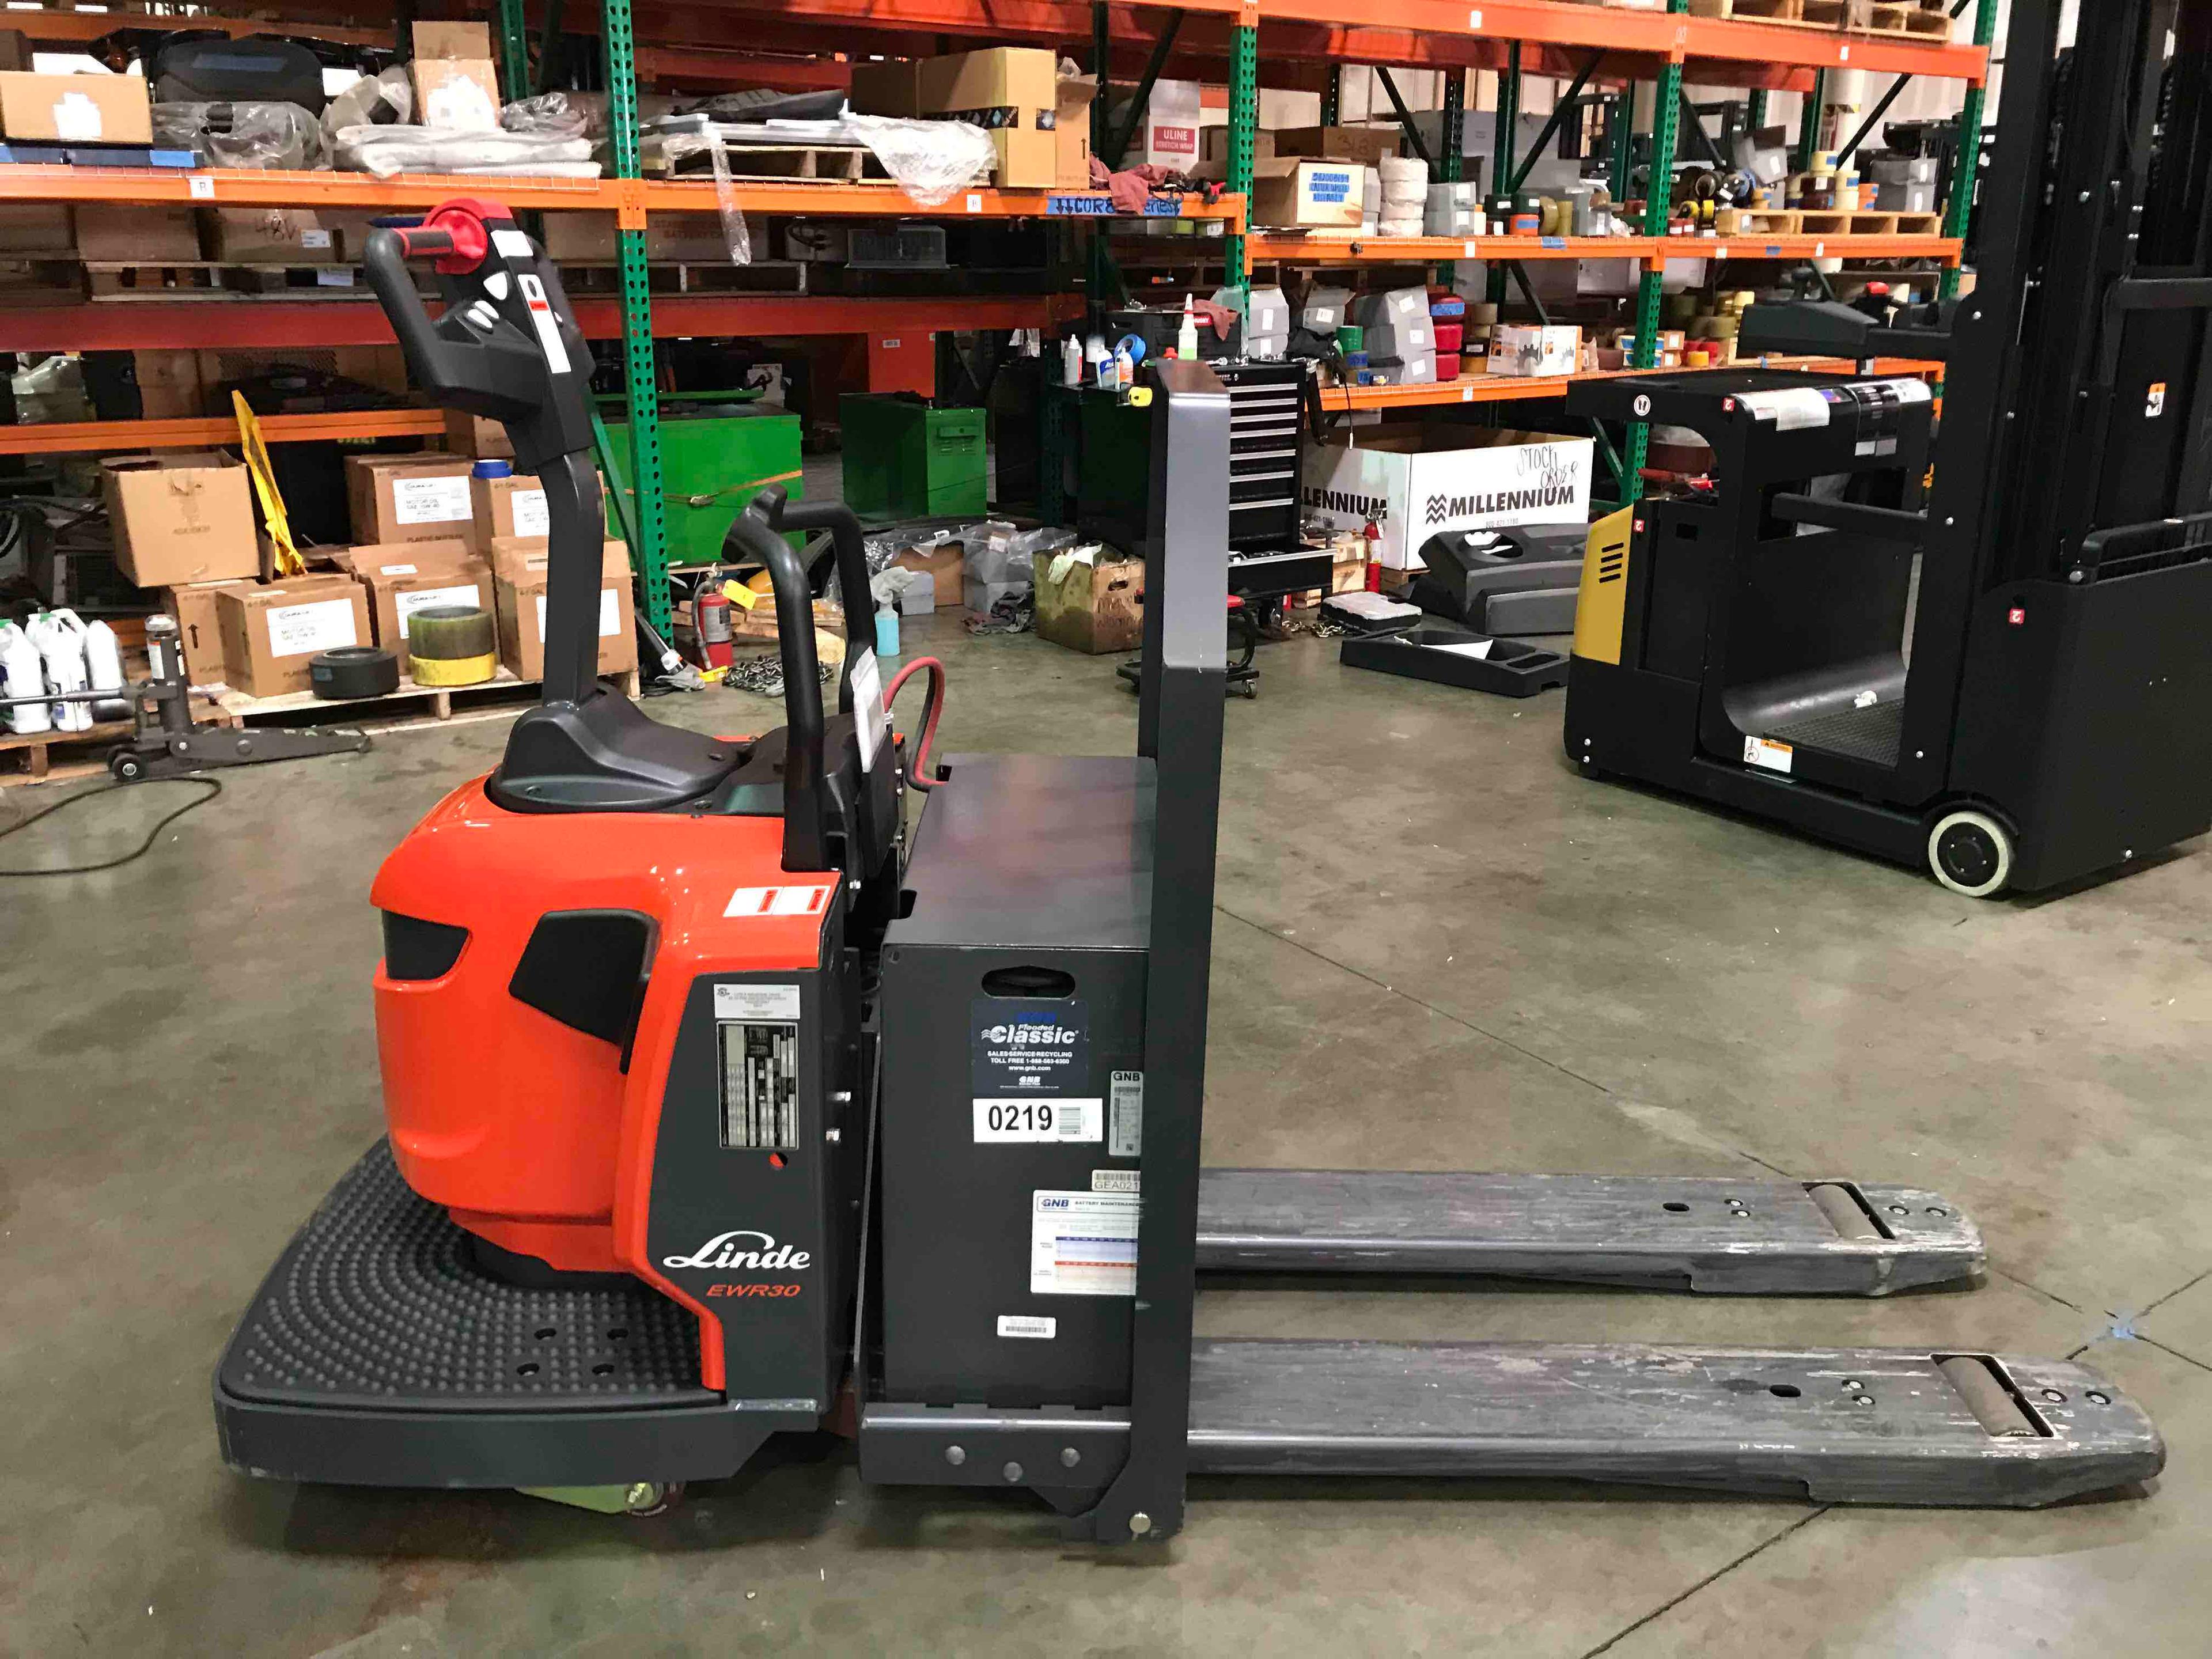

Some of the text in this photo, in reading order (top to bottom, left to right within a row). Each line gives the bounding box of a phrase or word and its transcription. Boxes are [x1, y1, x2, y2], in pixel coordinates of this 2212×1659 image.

[1163, 129, 1187, 140] ULINE
[1448, 485, 1574, 517] MILLENNIUM
[990, 1025, 1075, 1044] Classic
[1113, 1072, 1141, 1081] GNB
[988, 1105, 1052, 1131] 0219
[1042, 1199, 1070, 1207] GNB
[663, 1230, 810, 1269] Linde
[706, 1284, 801, 1297] EWR30
